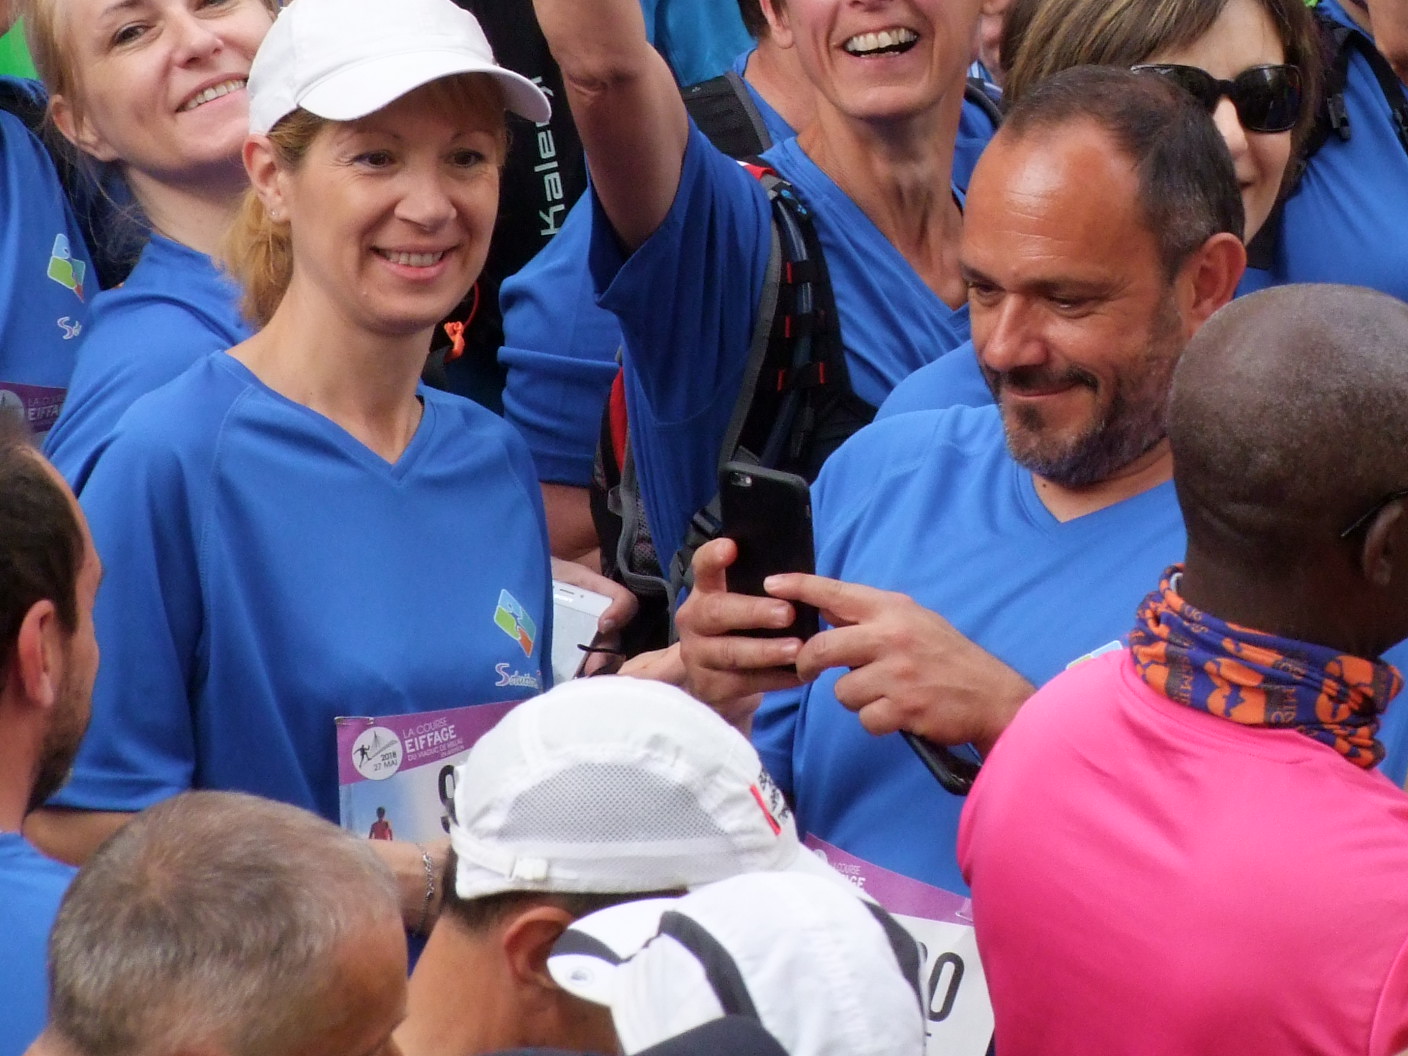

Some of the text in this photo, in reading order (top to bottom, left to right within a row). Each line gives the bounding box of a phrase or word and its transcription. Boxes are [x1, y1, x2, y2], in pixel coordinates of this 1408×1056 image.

[533, 75, 567, 236] Kale
[402, 717, 448, 740] LA COURSE
[404, 724, 457, 754] EIFFAGE
[373, 759, 399, 772] 27 MAI
[380, 751, 398, 762] 2018
[407, 752, 418, 762] DU
[848, 874, 867, 889] GE
[918, 941, 966, 1023] 0
